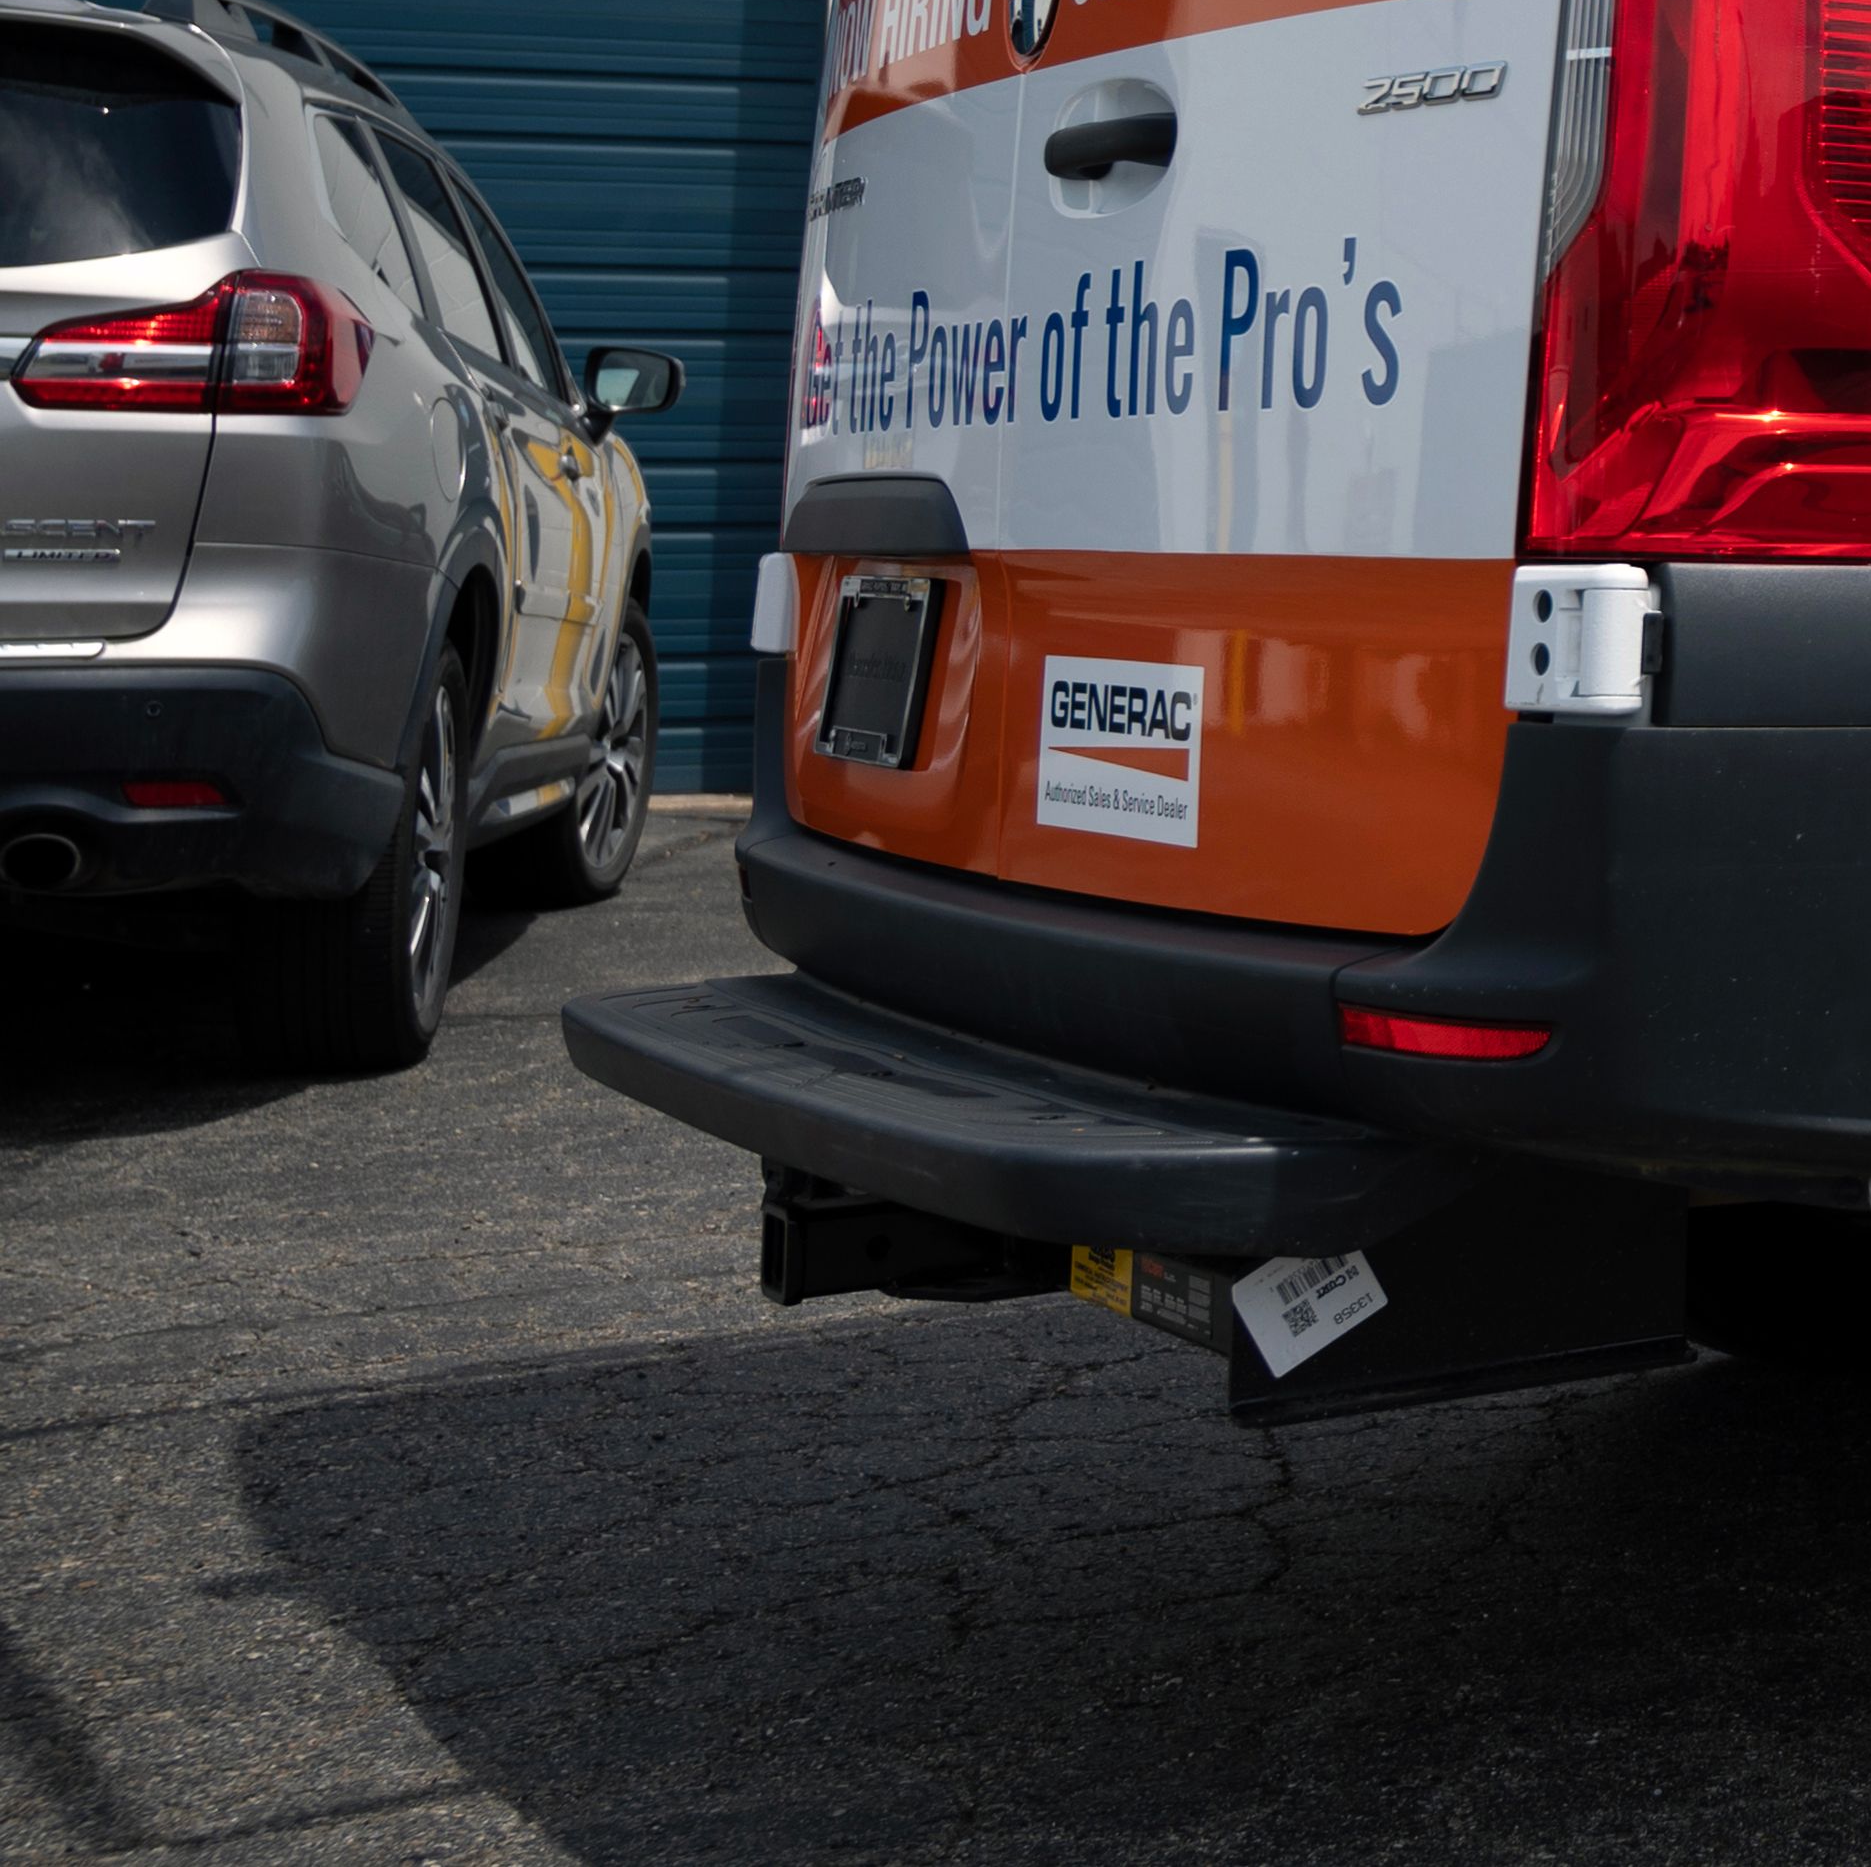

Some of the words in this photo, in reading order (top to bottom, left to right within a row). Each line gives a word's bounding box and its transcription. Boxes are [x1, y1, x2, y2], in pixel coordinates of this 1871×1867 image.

[1357, 60, 1508, 116] 2500
[850, 298, 895, 434] the
[906, 290, 1028, 429] Power
[1040, 271, 1091, 423] of
[1105, 260, 1195, 419] the
[1217, 236, 1403, 413] Pro's
[2, 518, 157, 544] SCENT
[1051, 680, 1192, 741] GENERAC
[1045, 781, 1087, 806] Authorized
[1088, 785, 1112, 809] Sales
[1113, 789, 1121, 810] &
[1121, 790, 1155, 815] Service
[1157, 795, 1189, 821] Dealer
[1333, 1293, 1374, 1326] 13358
